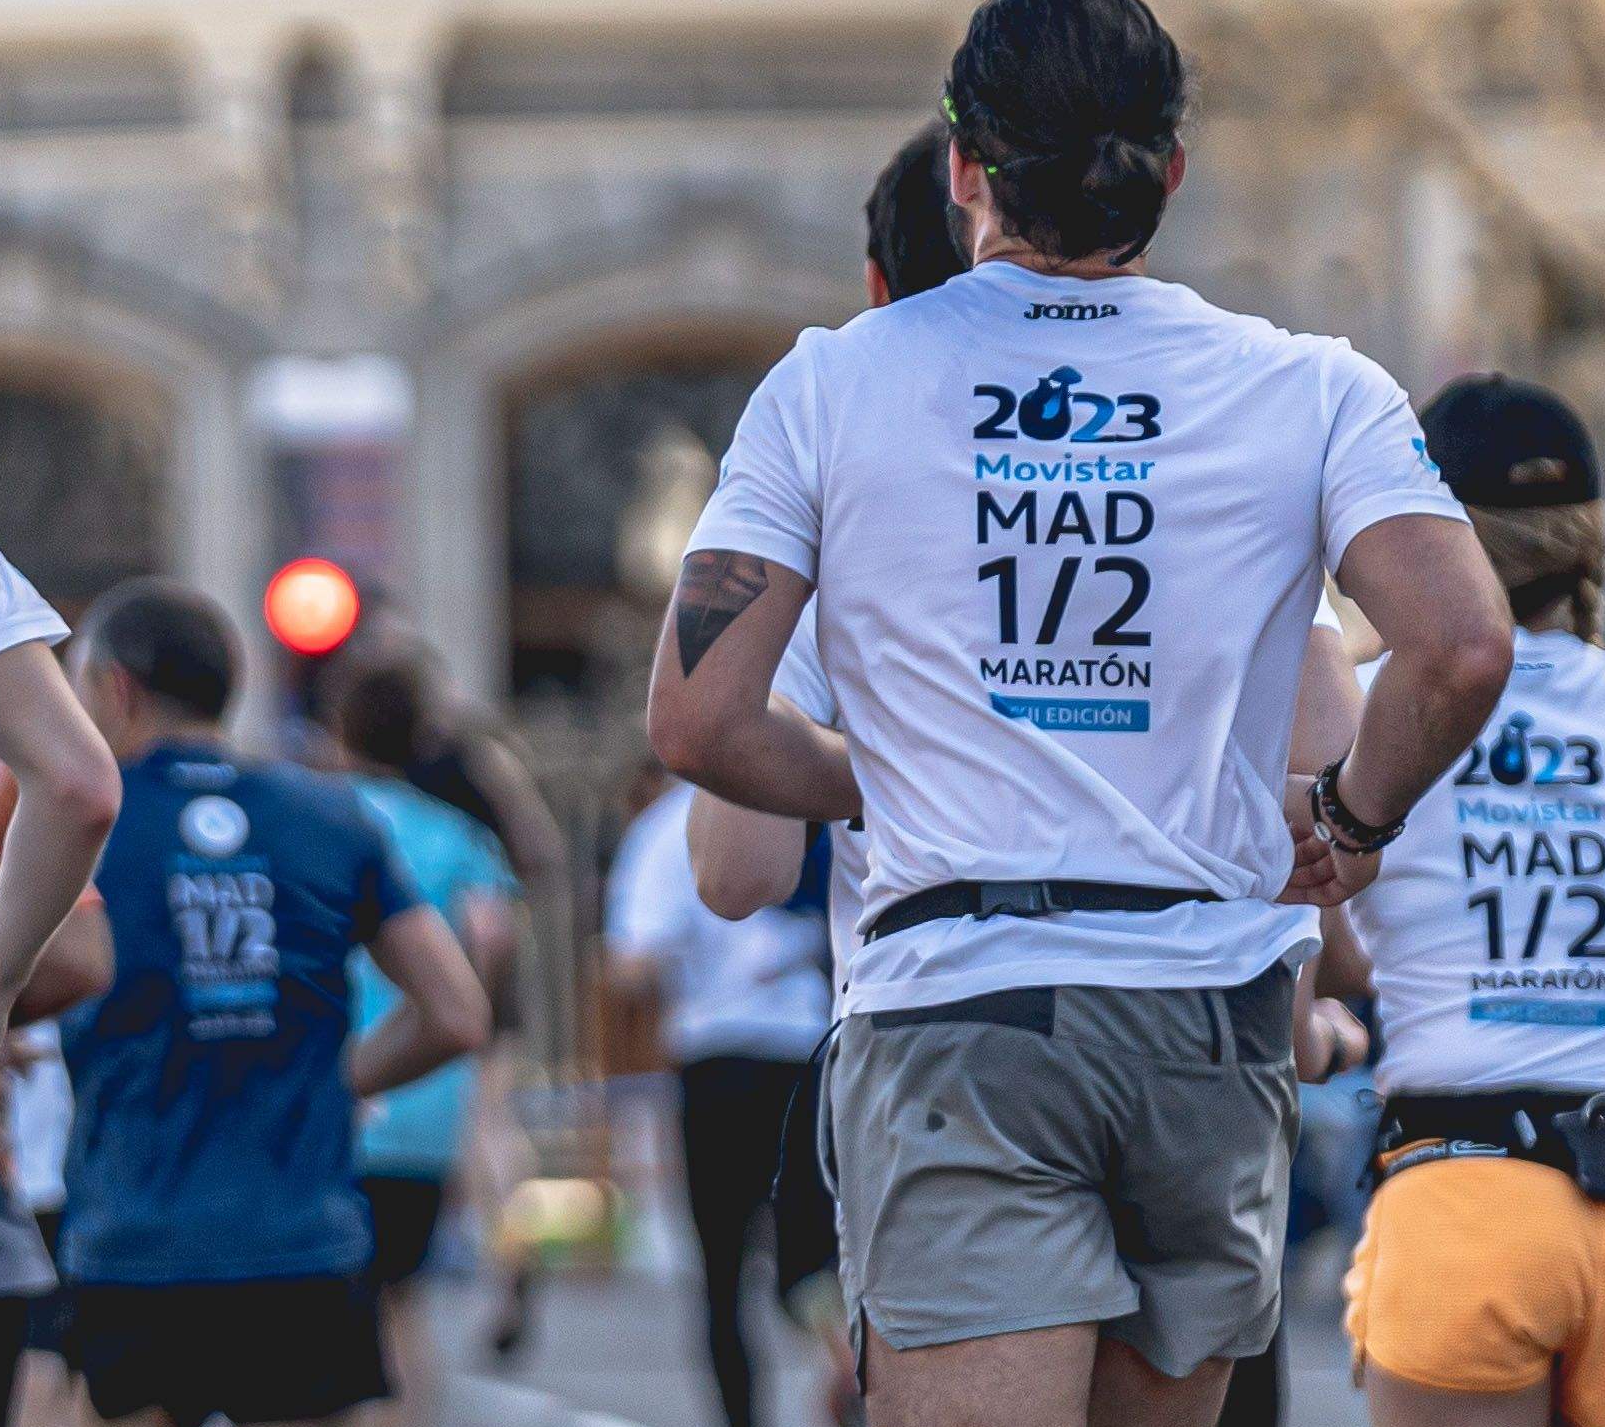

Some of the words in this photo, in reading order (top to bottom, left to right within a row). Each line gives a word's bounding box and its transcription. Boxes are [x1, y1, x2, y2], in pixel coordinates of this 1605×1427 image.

[1024, 303, 1121, 320] Joma
[973, 368, 1162, 442] 2023
[975, 453, 1156, 482] Movistar
[977, 491, 1156, 547] MAD
[977, 556, 1153, 648] 1/2
[981, 652, 1152, 688] MARATÓN
[1046, 703, 1132, 725] EDICIÓN
[1453, 712, 1605, 787] 2023
[1457, 797, 1603, 825] Movistar
[168, 871, 276, 911] MAD
[174, 908, 278, 960] 1/2
